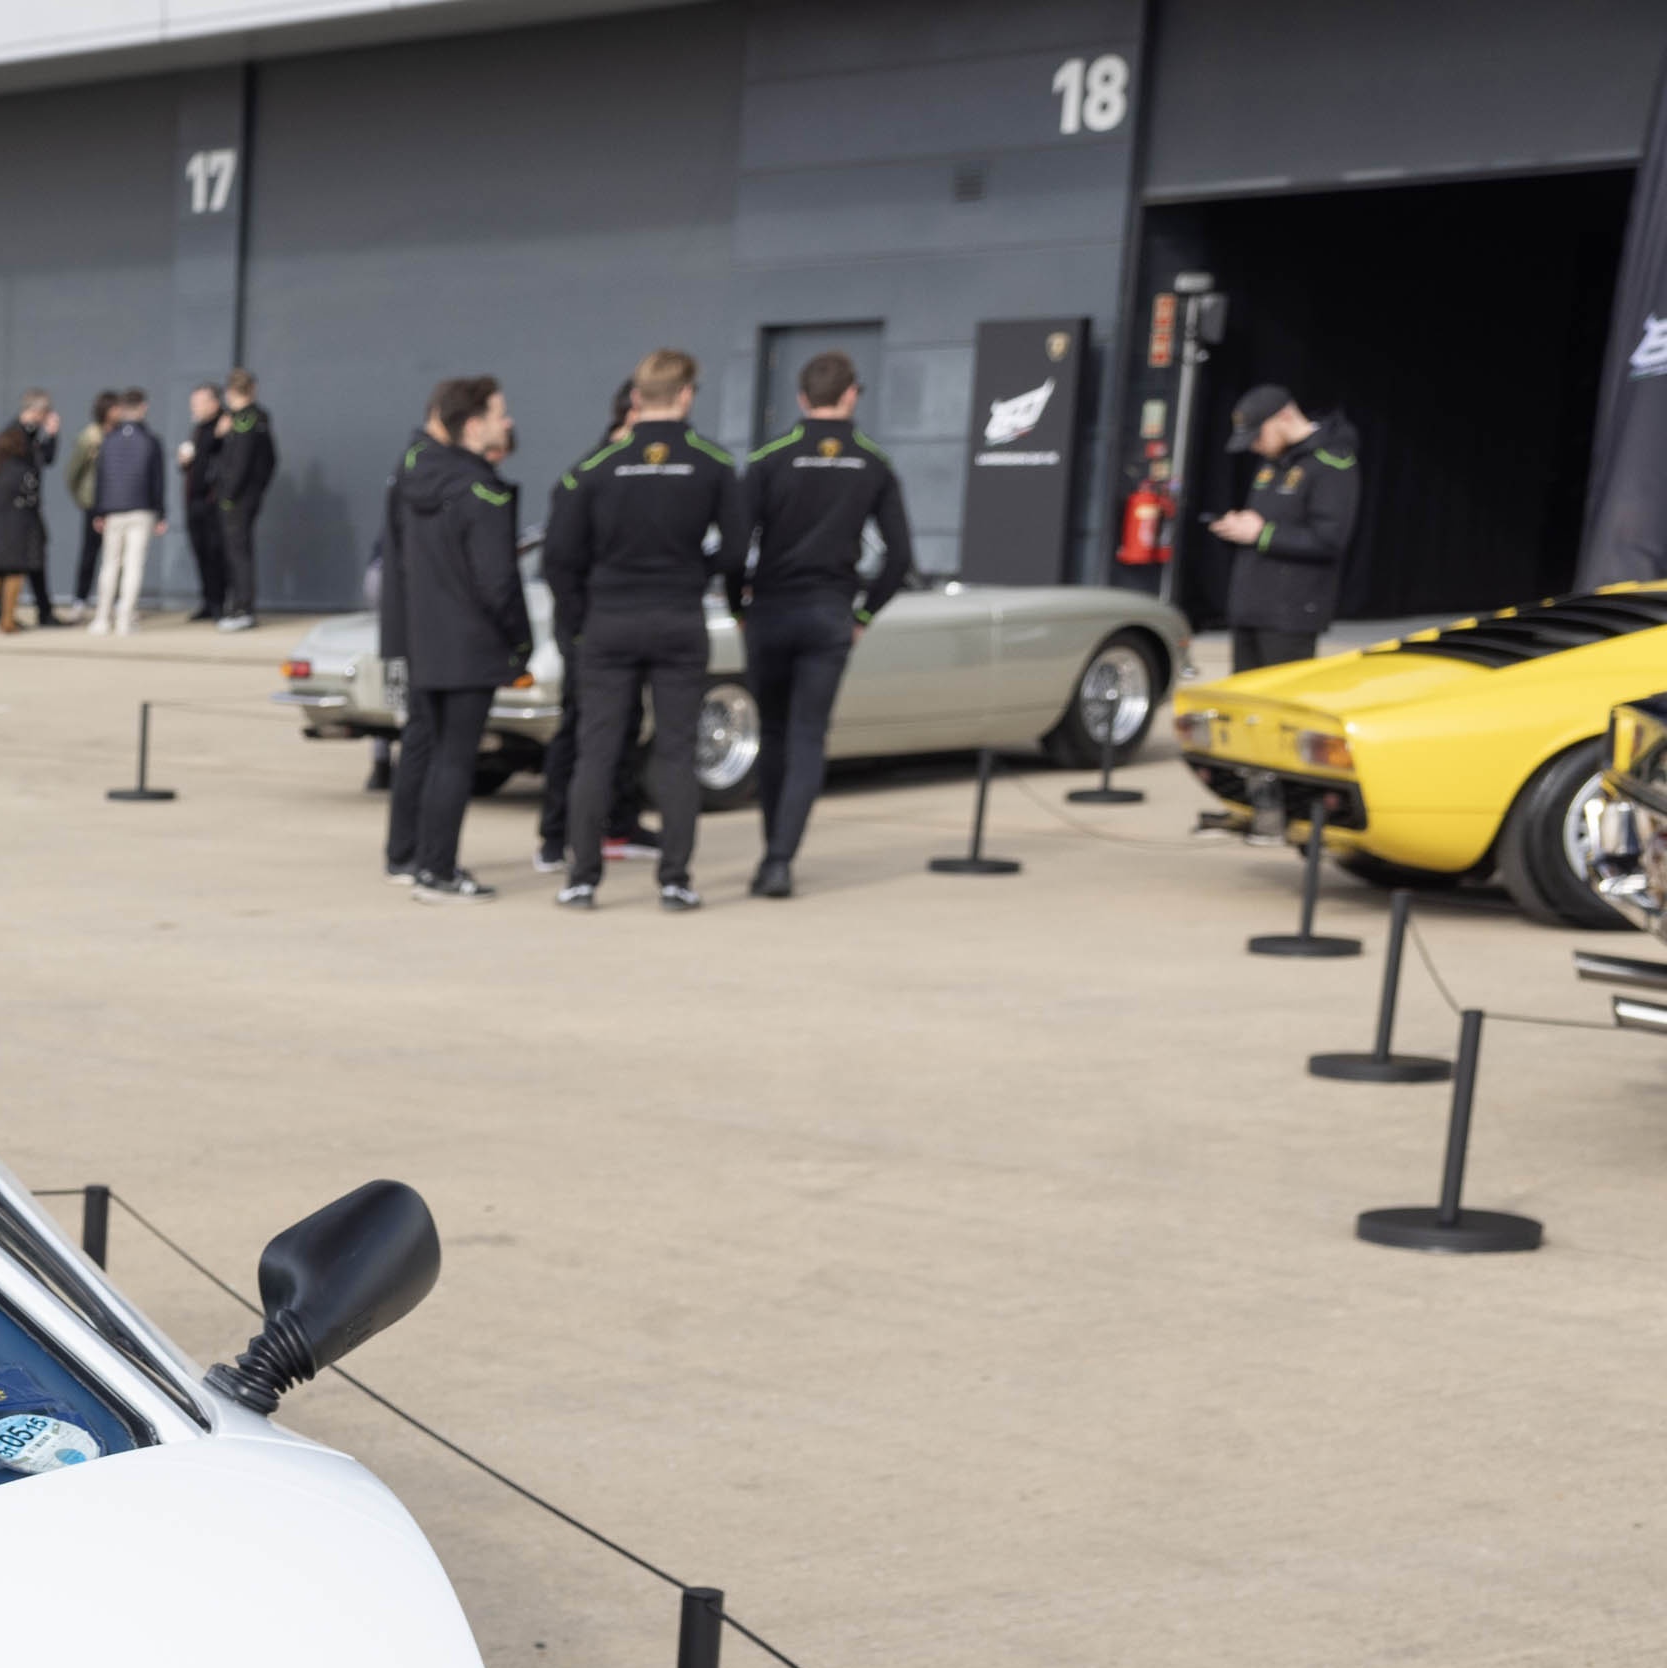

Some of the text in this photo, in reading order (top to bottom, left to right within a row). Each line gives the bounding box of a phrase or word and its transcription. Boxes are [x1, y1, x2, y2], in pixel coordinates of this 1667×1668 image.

[1051, 53, 1130, 135] 18
[185, 147, 238, 213] 17
[26, 1417, 48, 1433] 15
